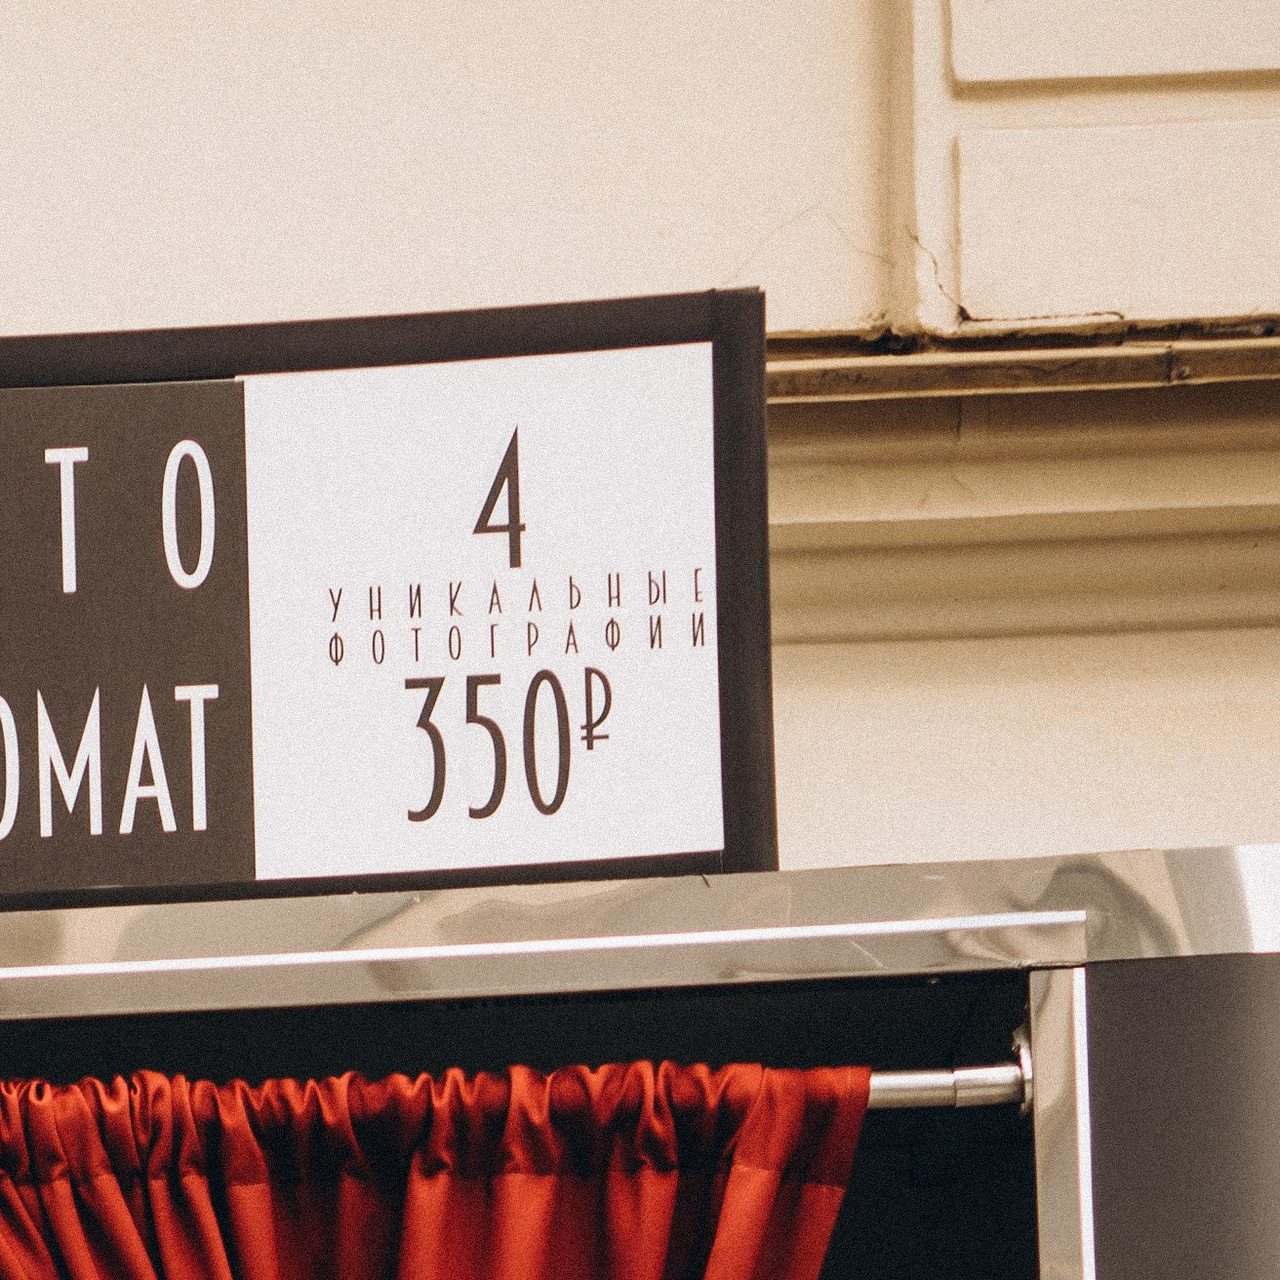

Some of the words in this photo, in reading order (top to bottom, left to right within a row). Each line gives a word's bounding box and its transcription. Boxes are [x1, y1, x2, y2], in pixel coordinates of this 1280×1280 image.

[473, 424, 526, 570] 4
[328, 568, 703, 623] УНИКАЛЬНЫЕ
[328, 612, 704, 666] ФОТОГРАФИИ
[404, 667, 612, 822] 350₽
